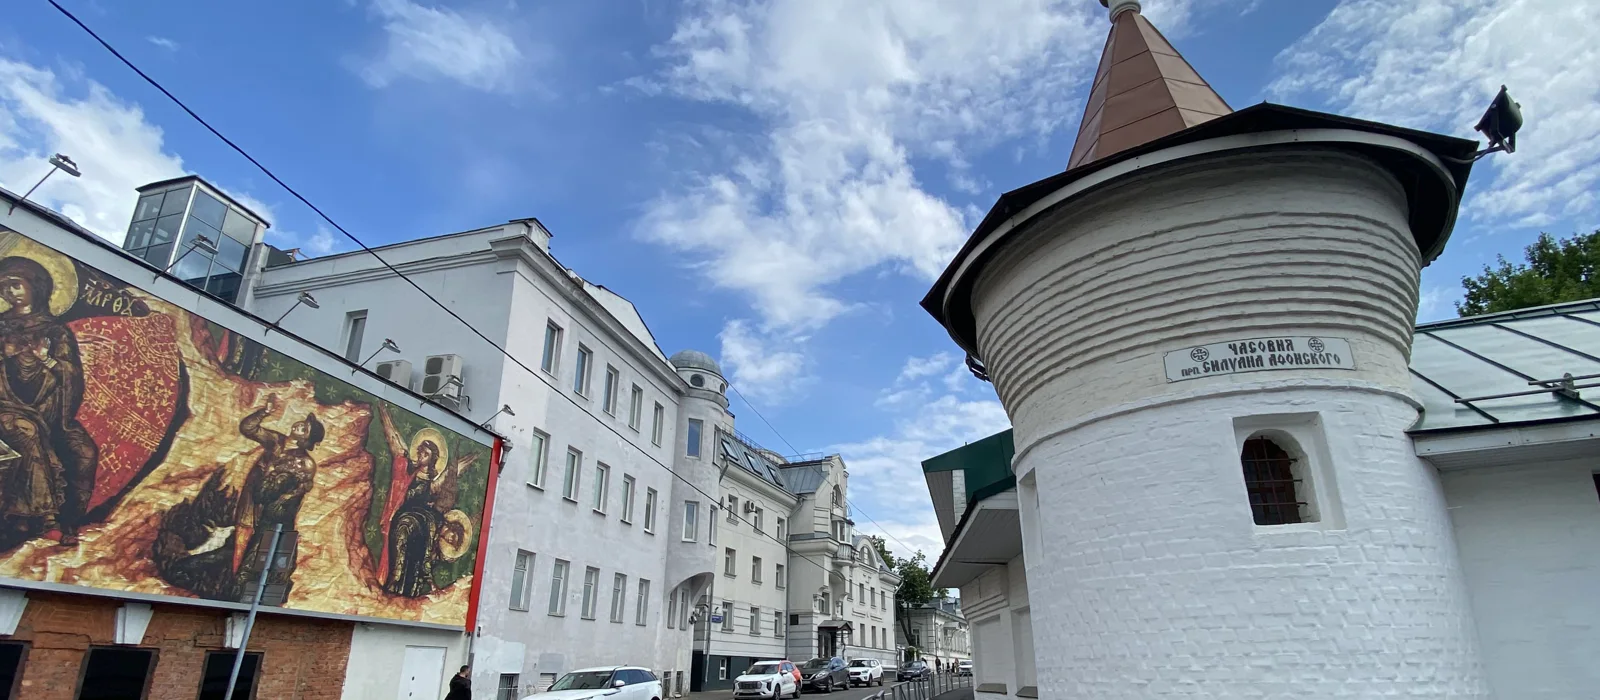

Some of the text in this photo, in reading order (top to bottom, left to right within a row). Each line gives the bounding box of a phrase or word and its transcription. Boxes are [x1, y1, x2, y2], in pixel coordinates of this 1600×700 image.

[1228, 339, 1294, 355] ЧАСОВНЯ
[1202, 354, 1264, 373] СИЛУАНА
[1268, 352, 1341, 367] АФОНСКОГО
